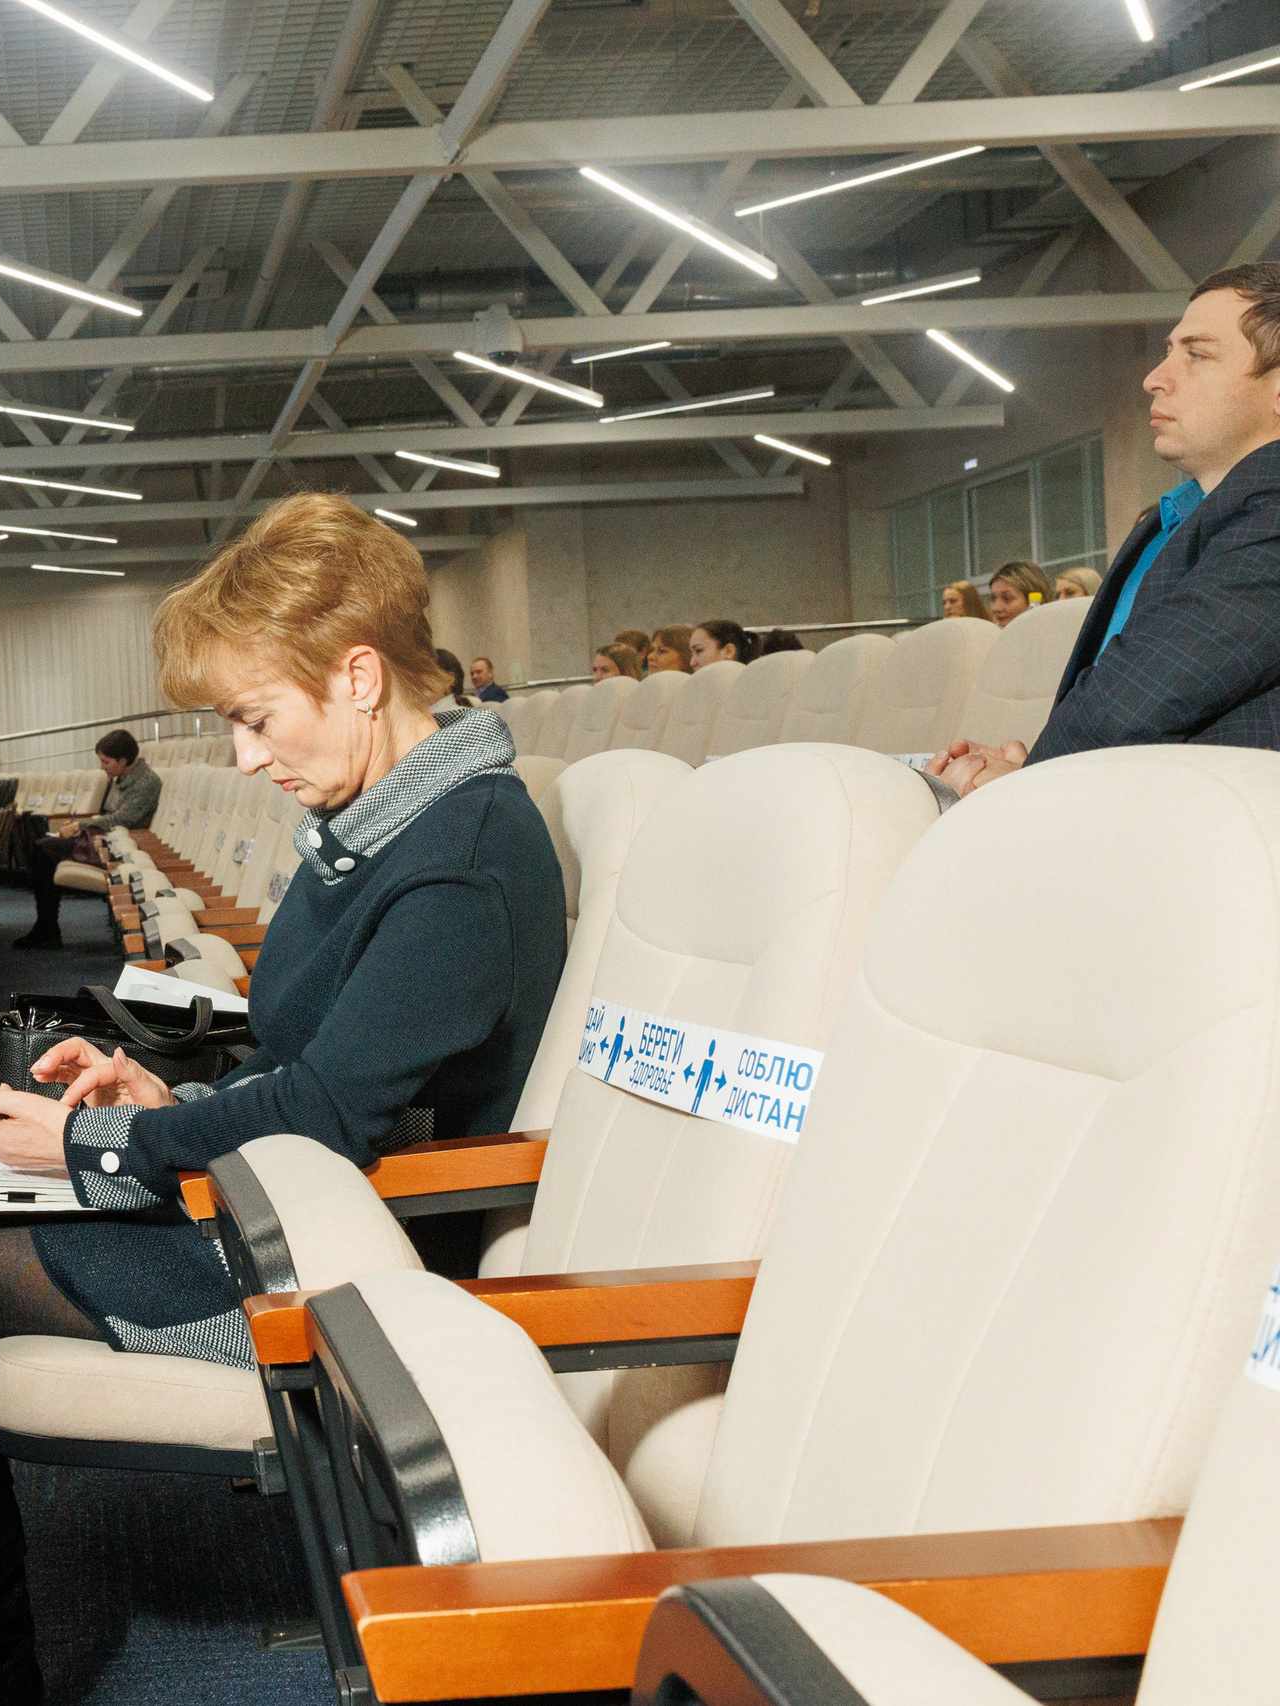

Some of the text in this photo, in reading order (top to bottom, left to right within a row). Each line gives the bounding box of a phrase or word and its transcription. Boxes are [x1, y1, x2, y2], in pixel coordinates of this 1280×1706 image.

[638, 1021, 686, 1065] БЕРЕГИ
[629, 1059, 676, 1095] ЗДОРОВЬЕ
[737, 1048, 814, 1092] СОБЛЮ
[722, 1086, 807, 1133] ДИСТАН
